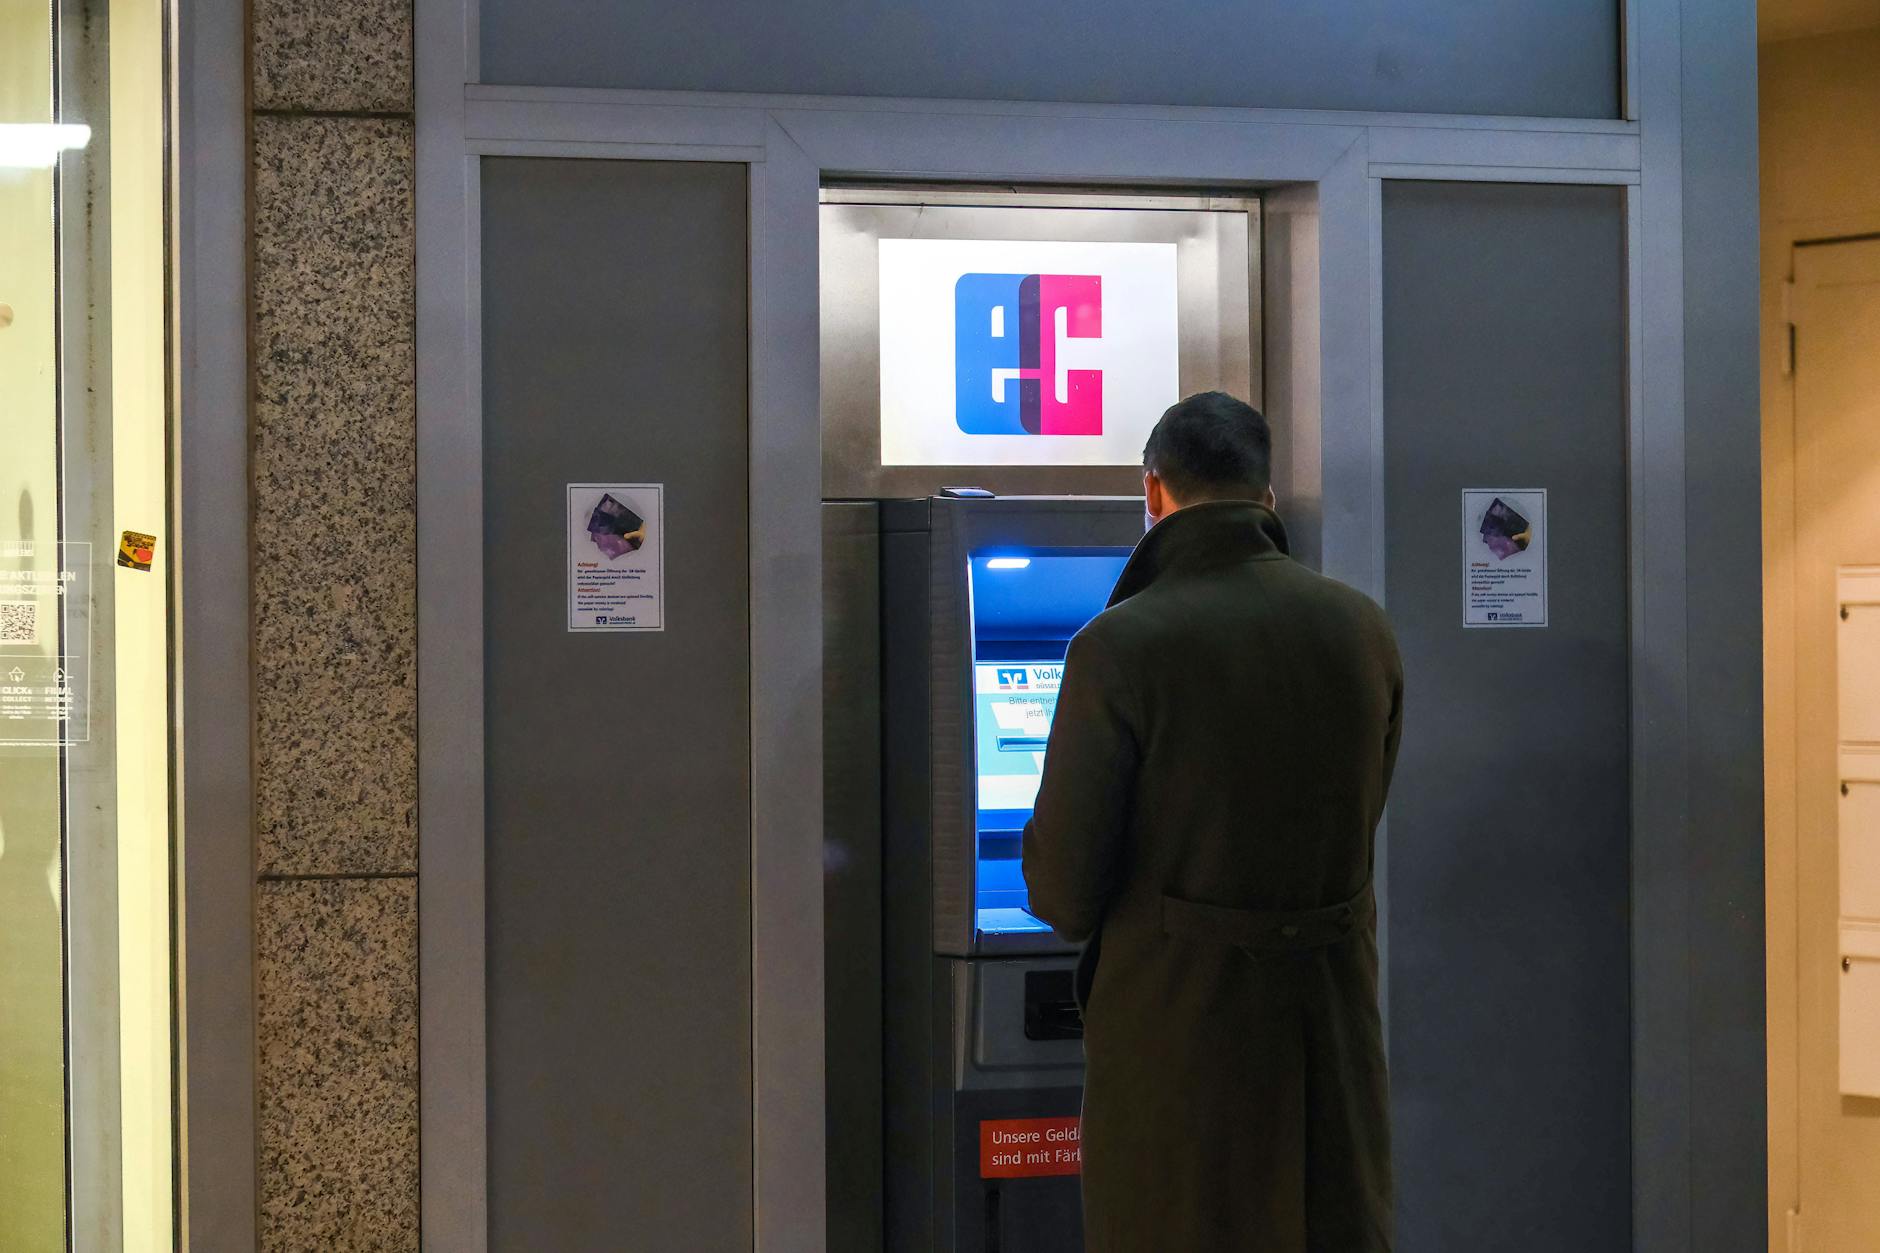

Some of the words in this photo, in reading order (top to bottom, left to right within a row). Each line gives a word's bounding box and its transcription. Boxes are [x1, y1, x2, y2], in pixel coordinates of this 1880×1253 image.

[1008, 697, 1028, 705] Bitte
[992, 1131, 1040, 1144] Unsere
[992, 1150, 1022, 1166] sind
[1027, 1149, 1051, 1164] mit
